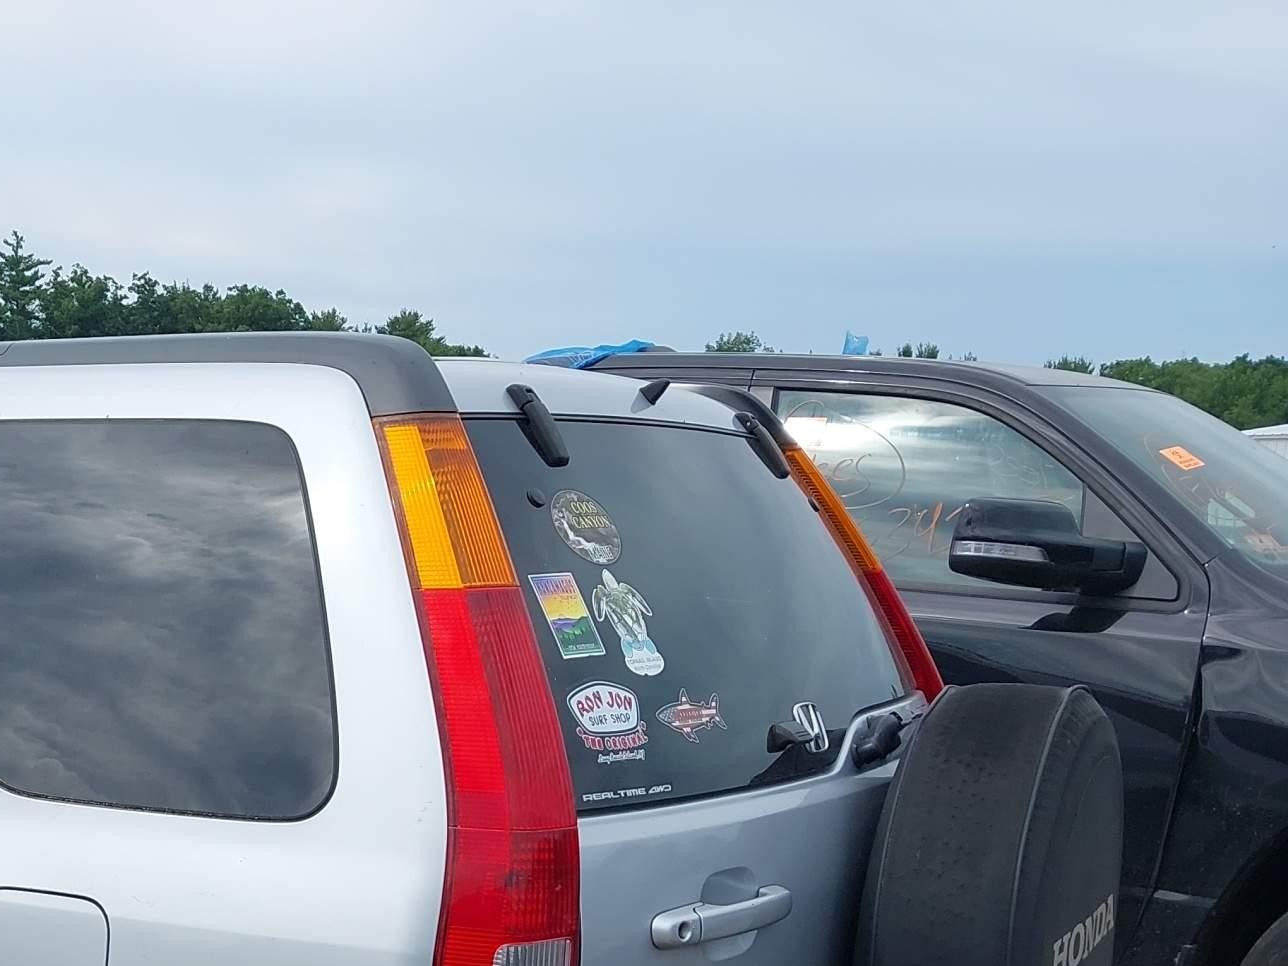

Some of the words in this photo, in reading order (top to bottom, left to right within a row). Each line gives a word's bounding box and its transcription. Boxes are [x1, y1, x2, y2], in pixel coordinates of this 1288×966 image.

[571, 501, 597, 513] COOS
[573, 515, 610, 529] CANYON
[576, 690, 603, 718] RON
[607, 691, 632, 712] JON
[589, 714, 607, 726] SURF
[610, 713, 630, 723] SHOP
[582, 734, 604, 750] THE
[605, 729, 648, 750] ORIGINAL
[648, 784, 672, 794] 4WD
